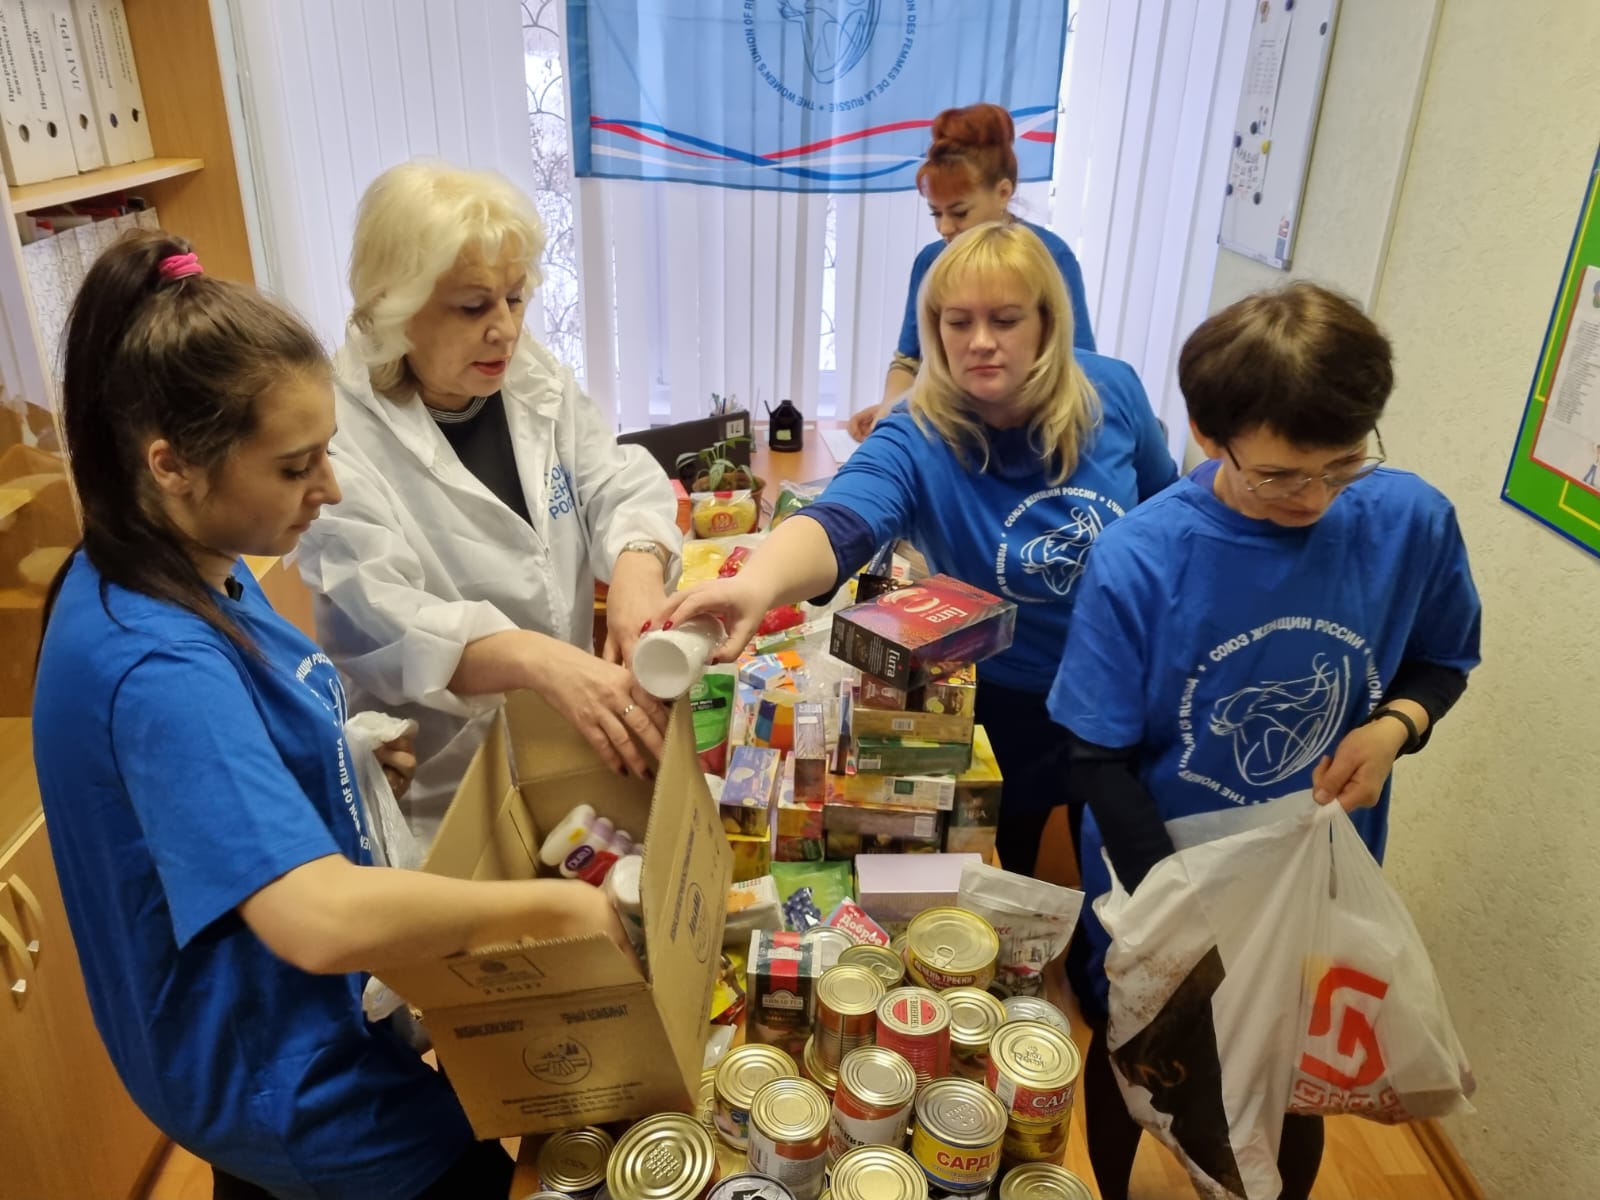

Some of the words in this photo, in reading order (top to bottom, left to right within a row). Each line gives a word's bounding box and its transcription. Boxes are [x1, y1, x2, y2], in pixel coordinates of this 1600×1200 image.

[744, 13, 753, 25] OF
[906, 14, 916, 34] DES
[744, 28, 762, 63] UNION
[888, 38, 914, 81] FEMMES
[758, 64, 796, 103] WOMEN'S
[876, 80, 890, 94] DE
[796, 95, 814, 110] THE
[829, 96, 864, 112] RUSSIE
[864, 90, 878, 103] LA
[1004, 504, 1026, 528] СОЮЗ
[1024, 487, 1062, 509] ЖЕНЩИН
[1062, 487, 1097, 502] РОССИИ
[996, 542, 1008, 575] RUSSIA
[1208, 633, 1250, 662] СОЮЗ
[1251, 616, 1312, 642] ЖЕНЩИН
[1314, 618, 1366, 650] РОССИИ
[336, 737, 350, 786] RUSSIA
[342, 788, 352, 804] OF
[1220, 786, 1246, 805] THE
